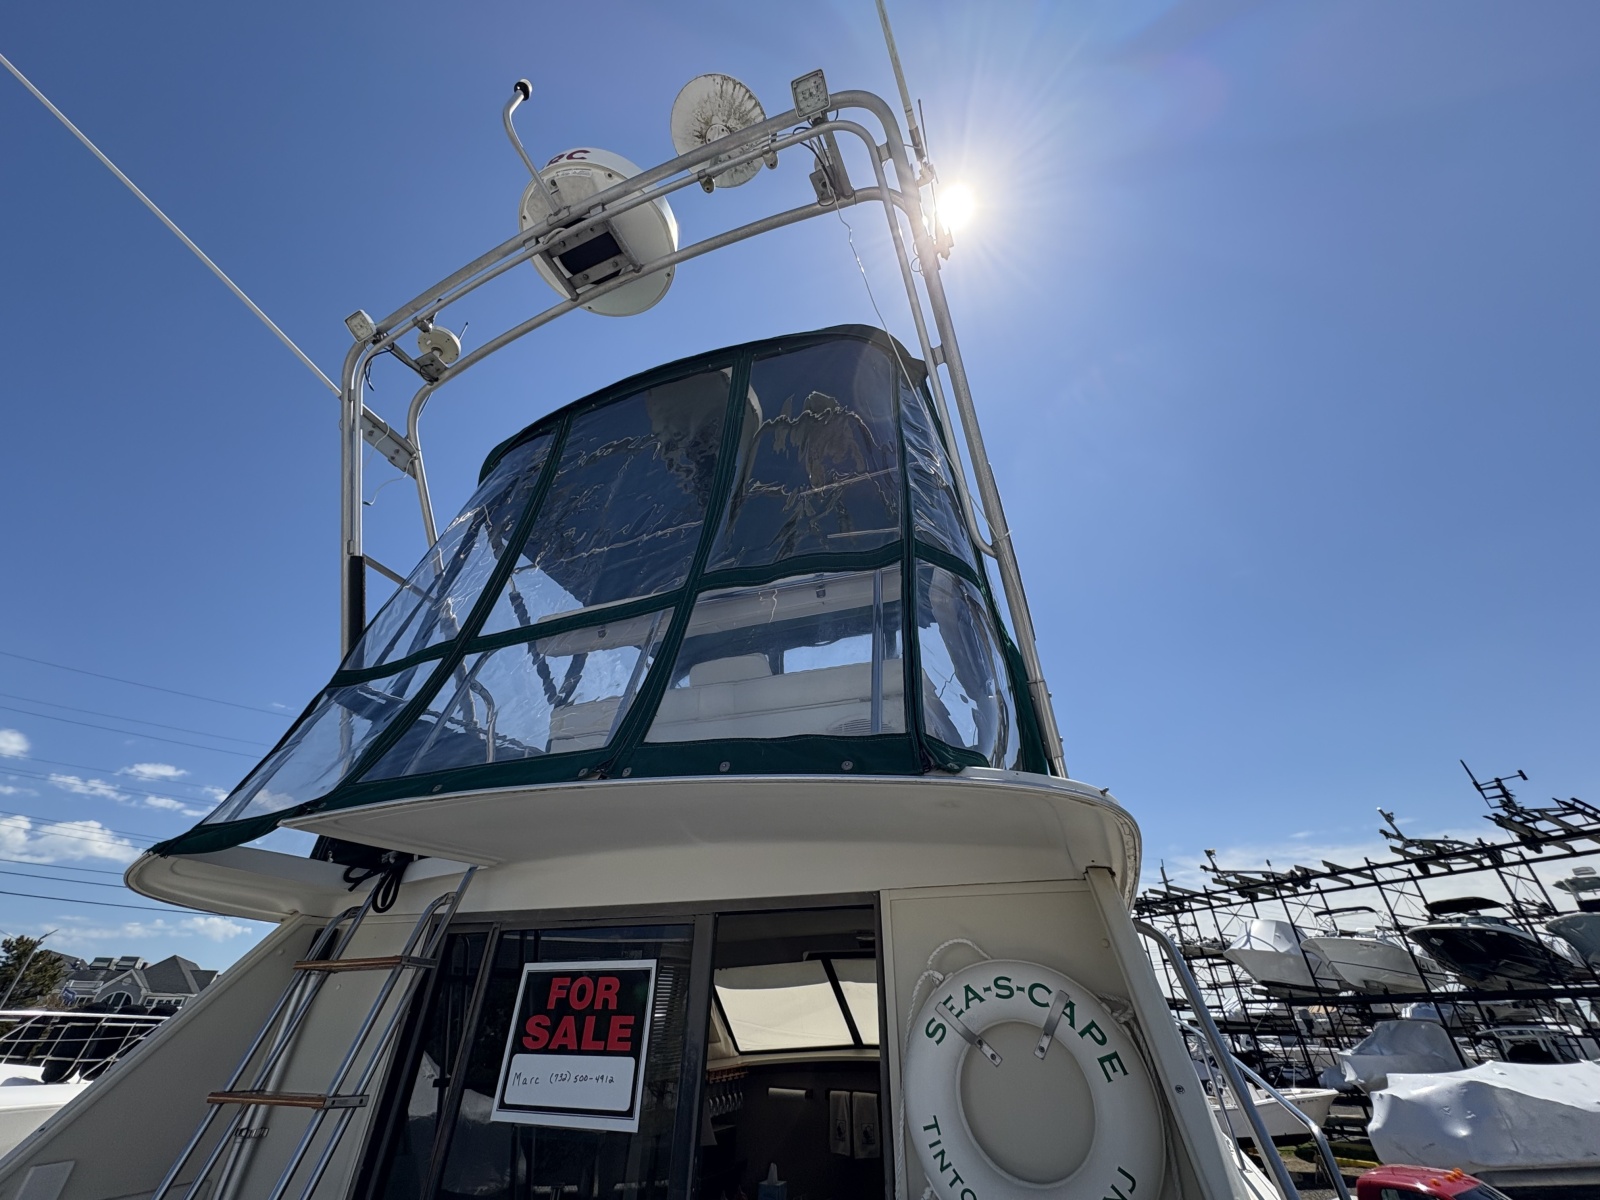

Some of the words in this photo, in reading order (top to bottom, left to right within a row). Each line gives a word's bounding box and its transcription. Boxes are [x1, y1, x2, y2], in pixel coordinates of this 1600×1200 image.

[547, 976, 620, 1010] FOR
[522, 1014, 635, 1052] SALE
[925, 976, 1129, 1083] SEA-S-CAPE
[512, 1072, 540, 1086] Marc
[549, 1070, 571, 1084] (732)
[573, 1074, 615, 1084] 500-4912
